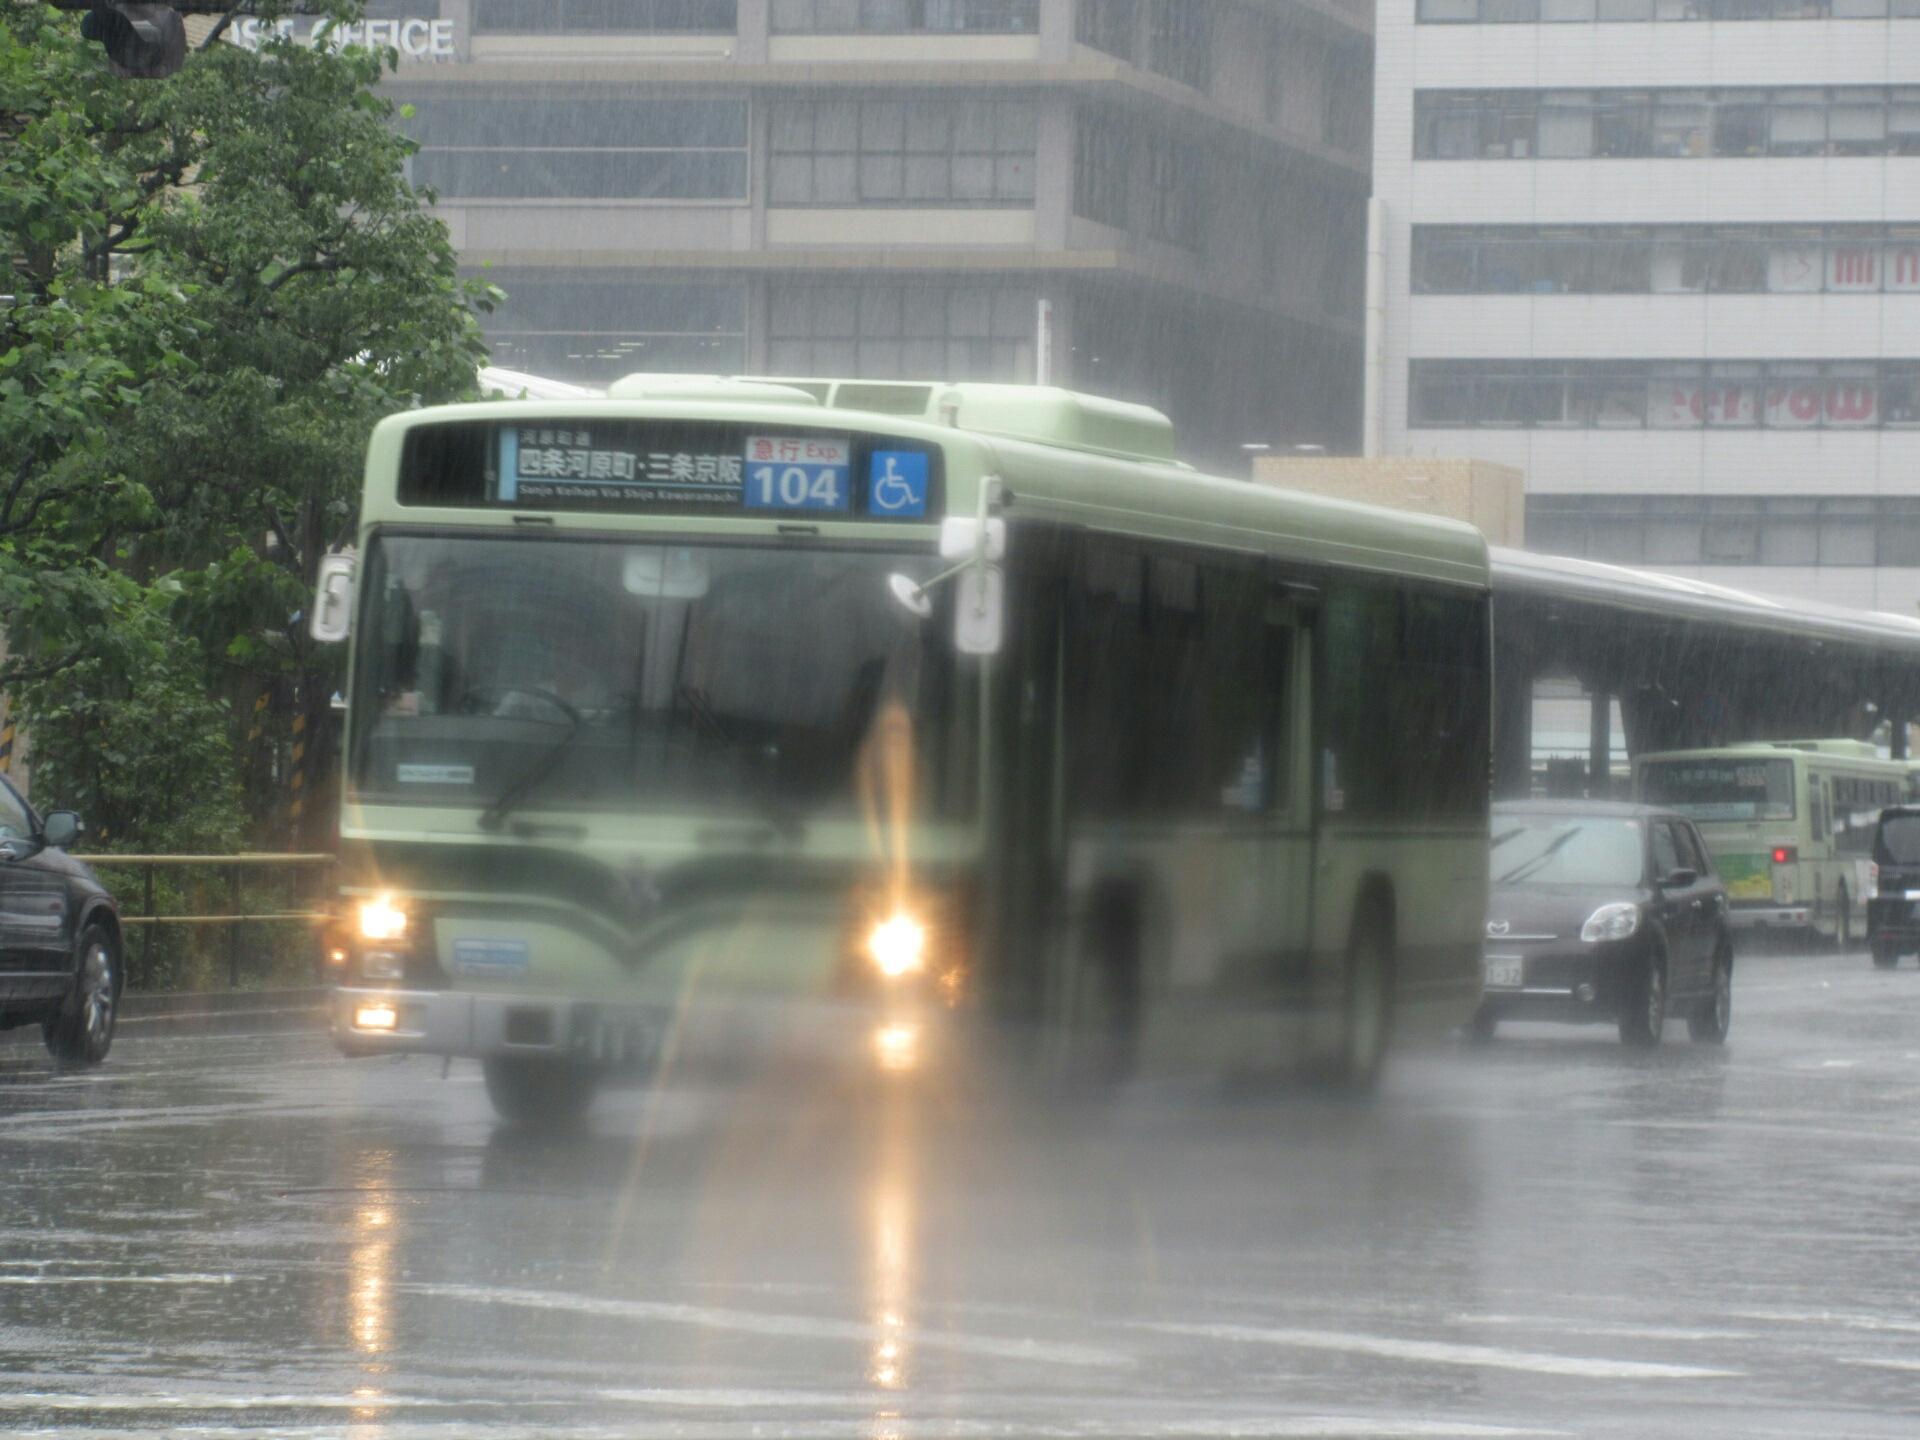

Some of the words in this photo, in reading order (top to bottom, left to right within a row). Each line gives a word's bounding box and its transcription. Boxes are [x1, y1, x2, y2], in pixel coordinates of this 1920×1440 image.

[310, 18, 455, 55] OFFICE
[752, 438, 800, 463] 急行
[753, 466, 839, 506] 104
